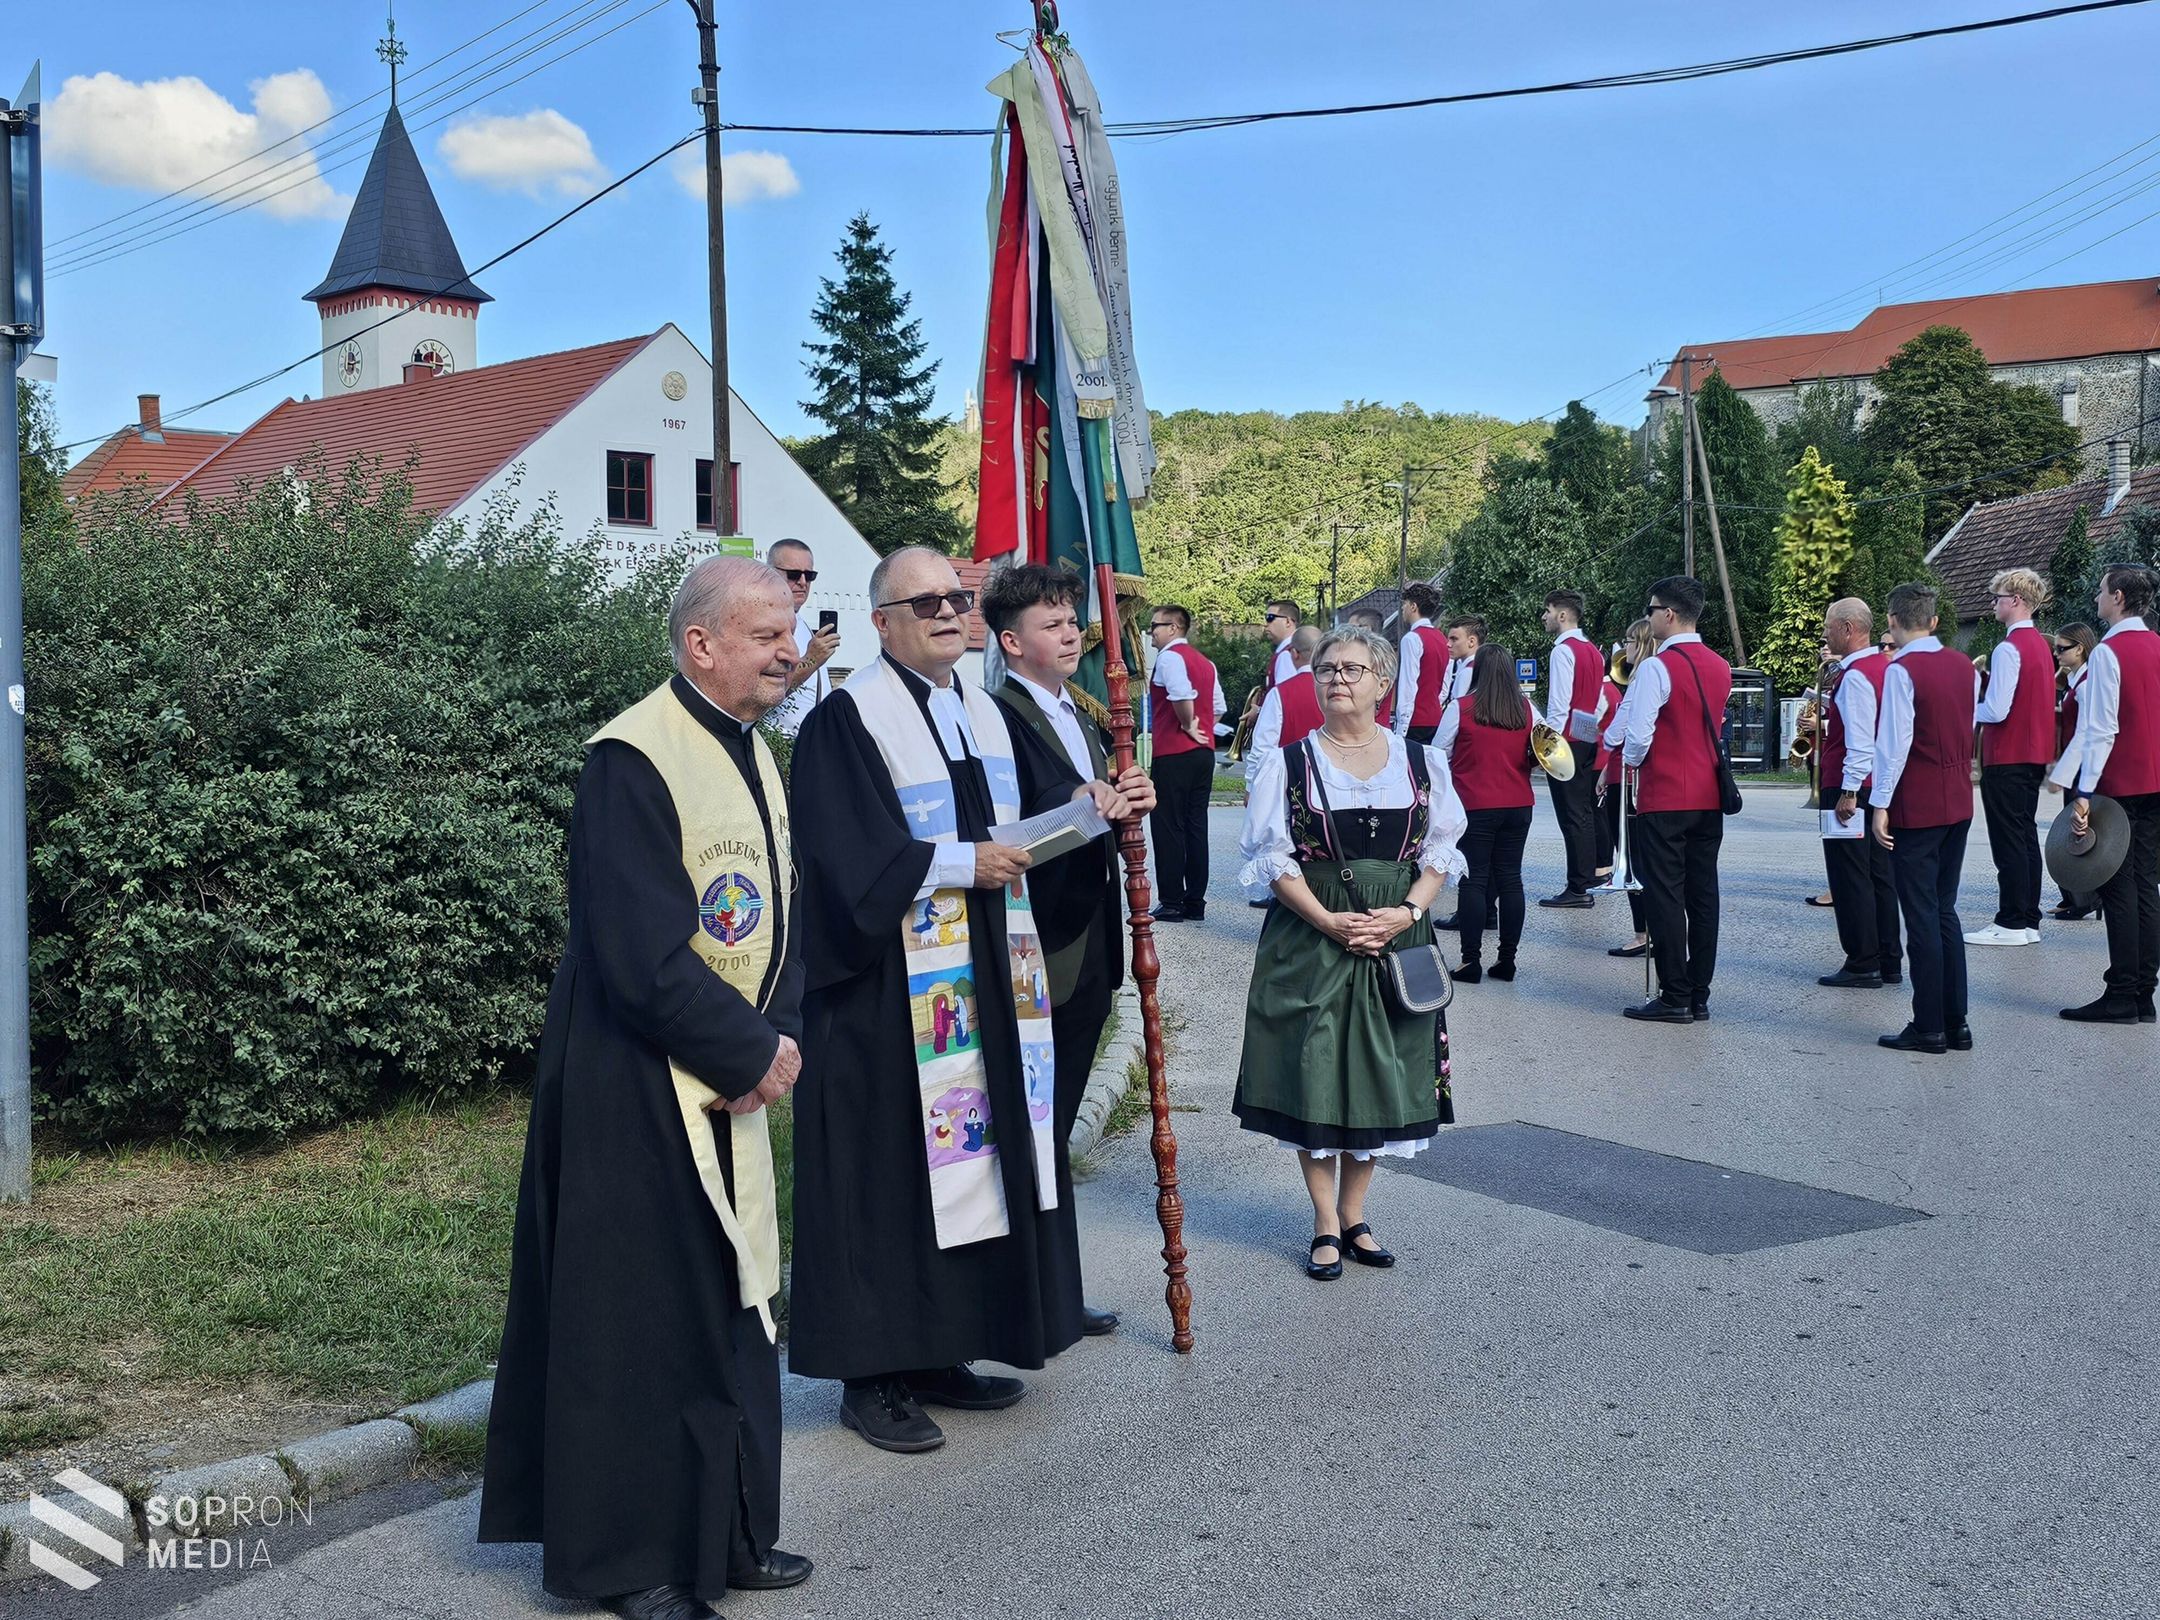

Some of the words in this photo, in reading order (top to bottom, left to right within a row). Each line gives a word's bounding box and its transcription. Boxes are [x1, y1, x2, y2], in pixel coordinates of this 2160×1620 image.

[1075, 373, 1108, 387] 2001.
[662, 418, 686, 430] 1967
[698, 840, 761, 867] JUBILEUM
[706, 954, 751, 972] 2000
